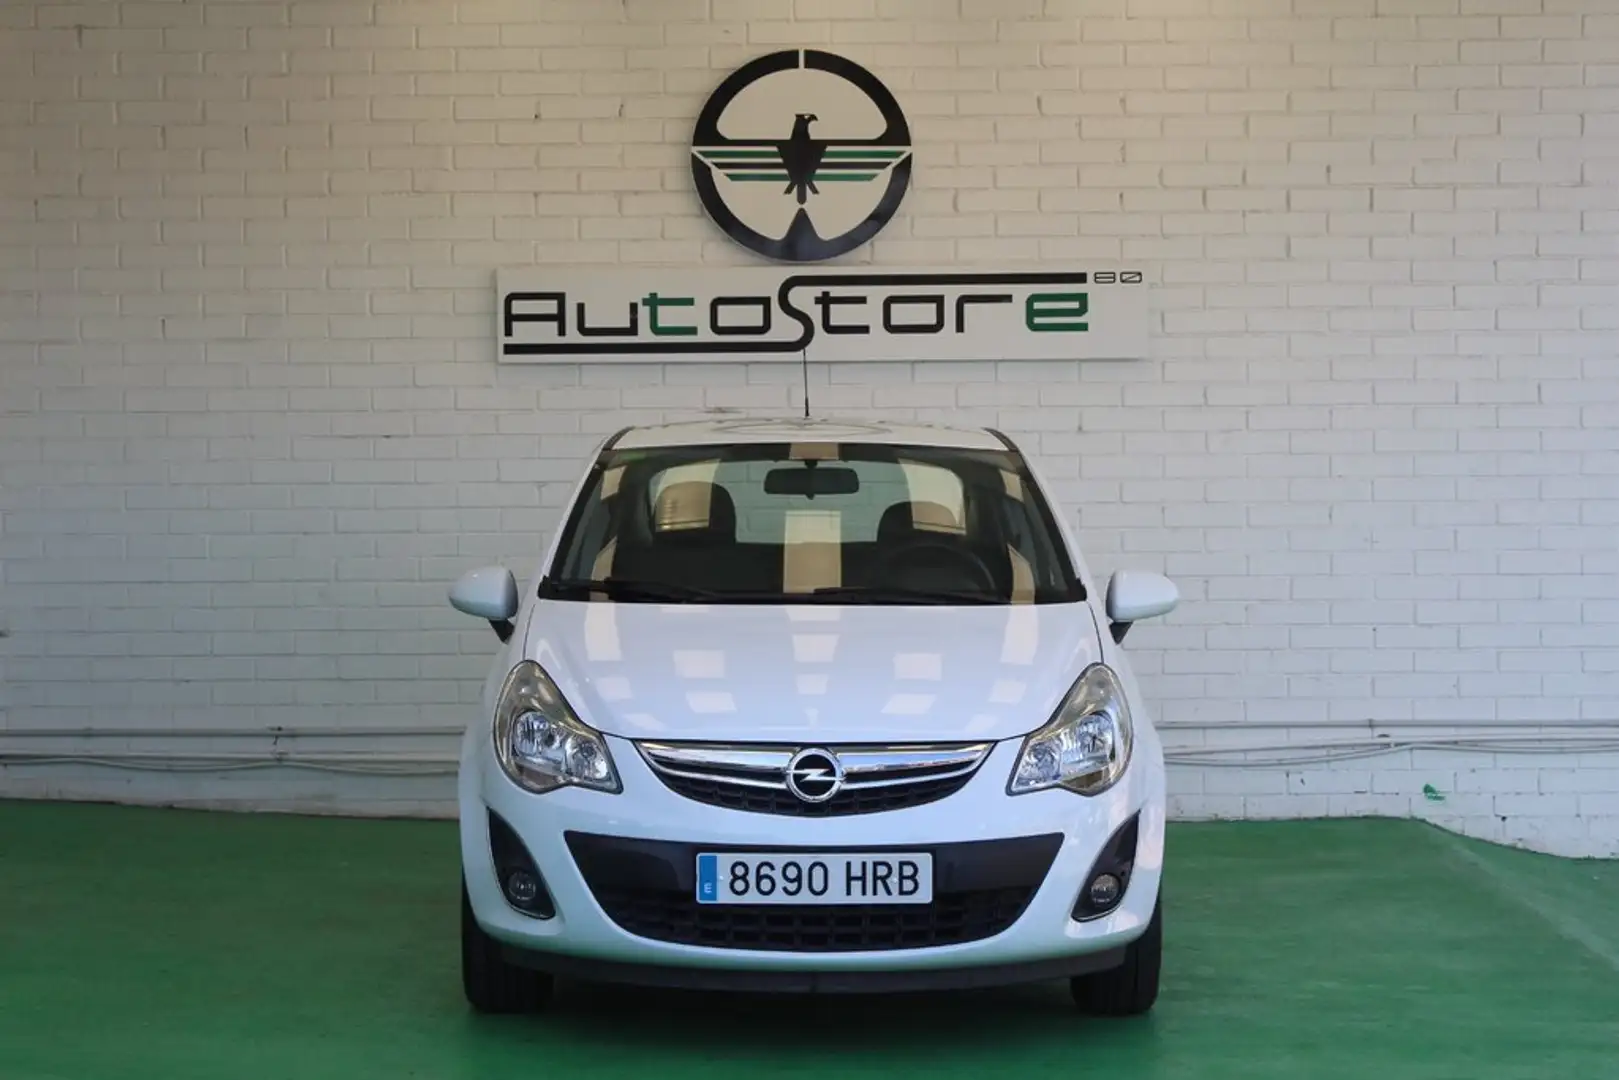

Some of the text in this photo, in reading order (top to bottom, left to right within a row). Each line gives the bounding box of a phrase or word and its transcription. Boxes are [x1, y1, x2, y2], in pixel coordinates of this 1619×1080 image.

[1094, 271, 1142, 284] 80
[729, 861, 829, 896] 8690
[845, 861, 919, 896] HRB
